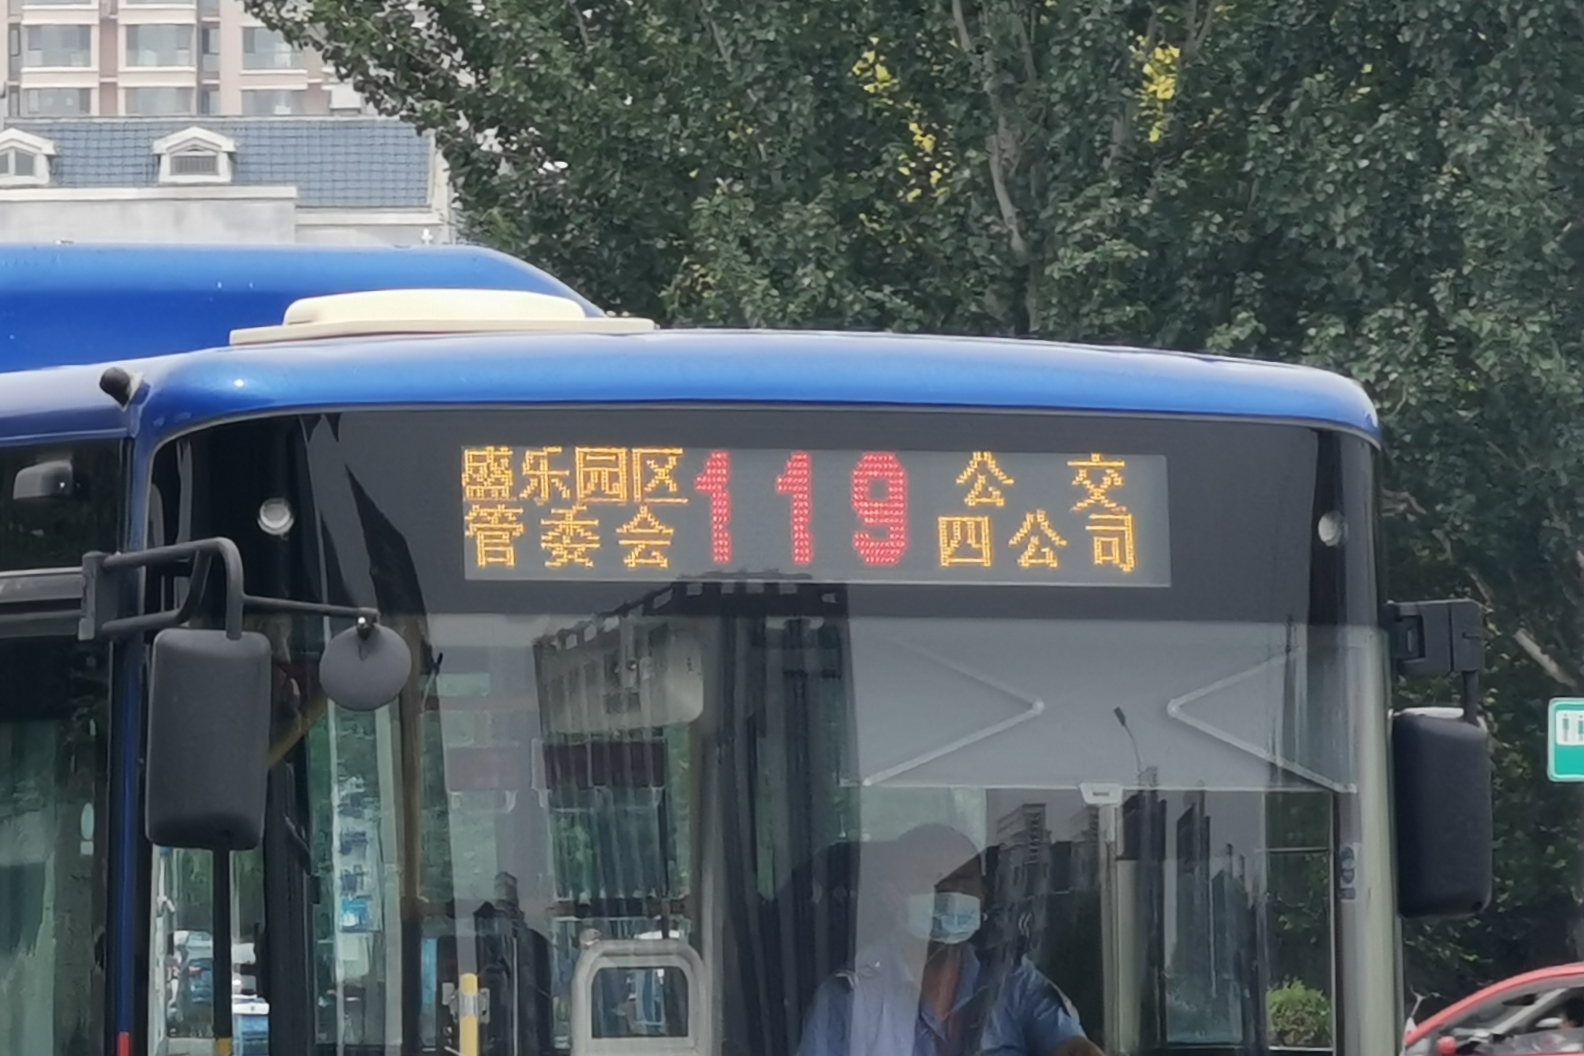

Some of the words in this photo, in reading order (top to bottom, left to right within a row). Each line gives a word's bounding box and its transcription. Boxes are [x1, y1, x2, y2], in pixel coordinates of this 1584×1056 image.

[464, 503, 675, 568] 管委会
[695, 452, 907, 566] 119
[938, 509, 1135, 572] 四公司
